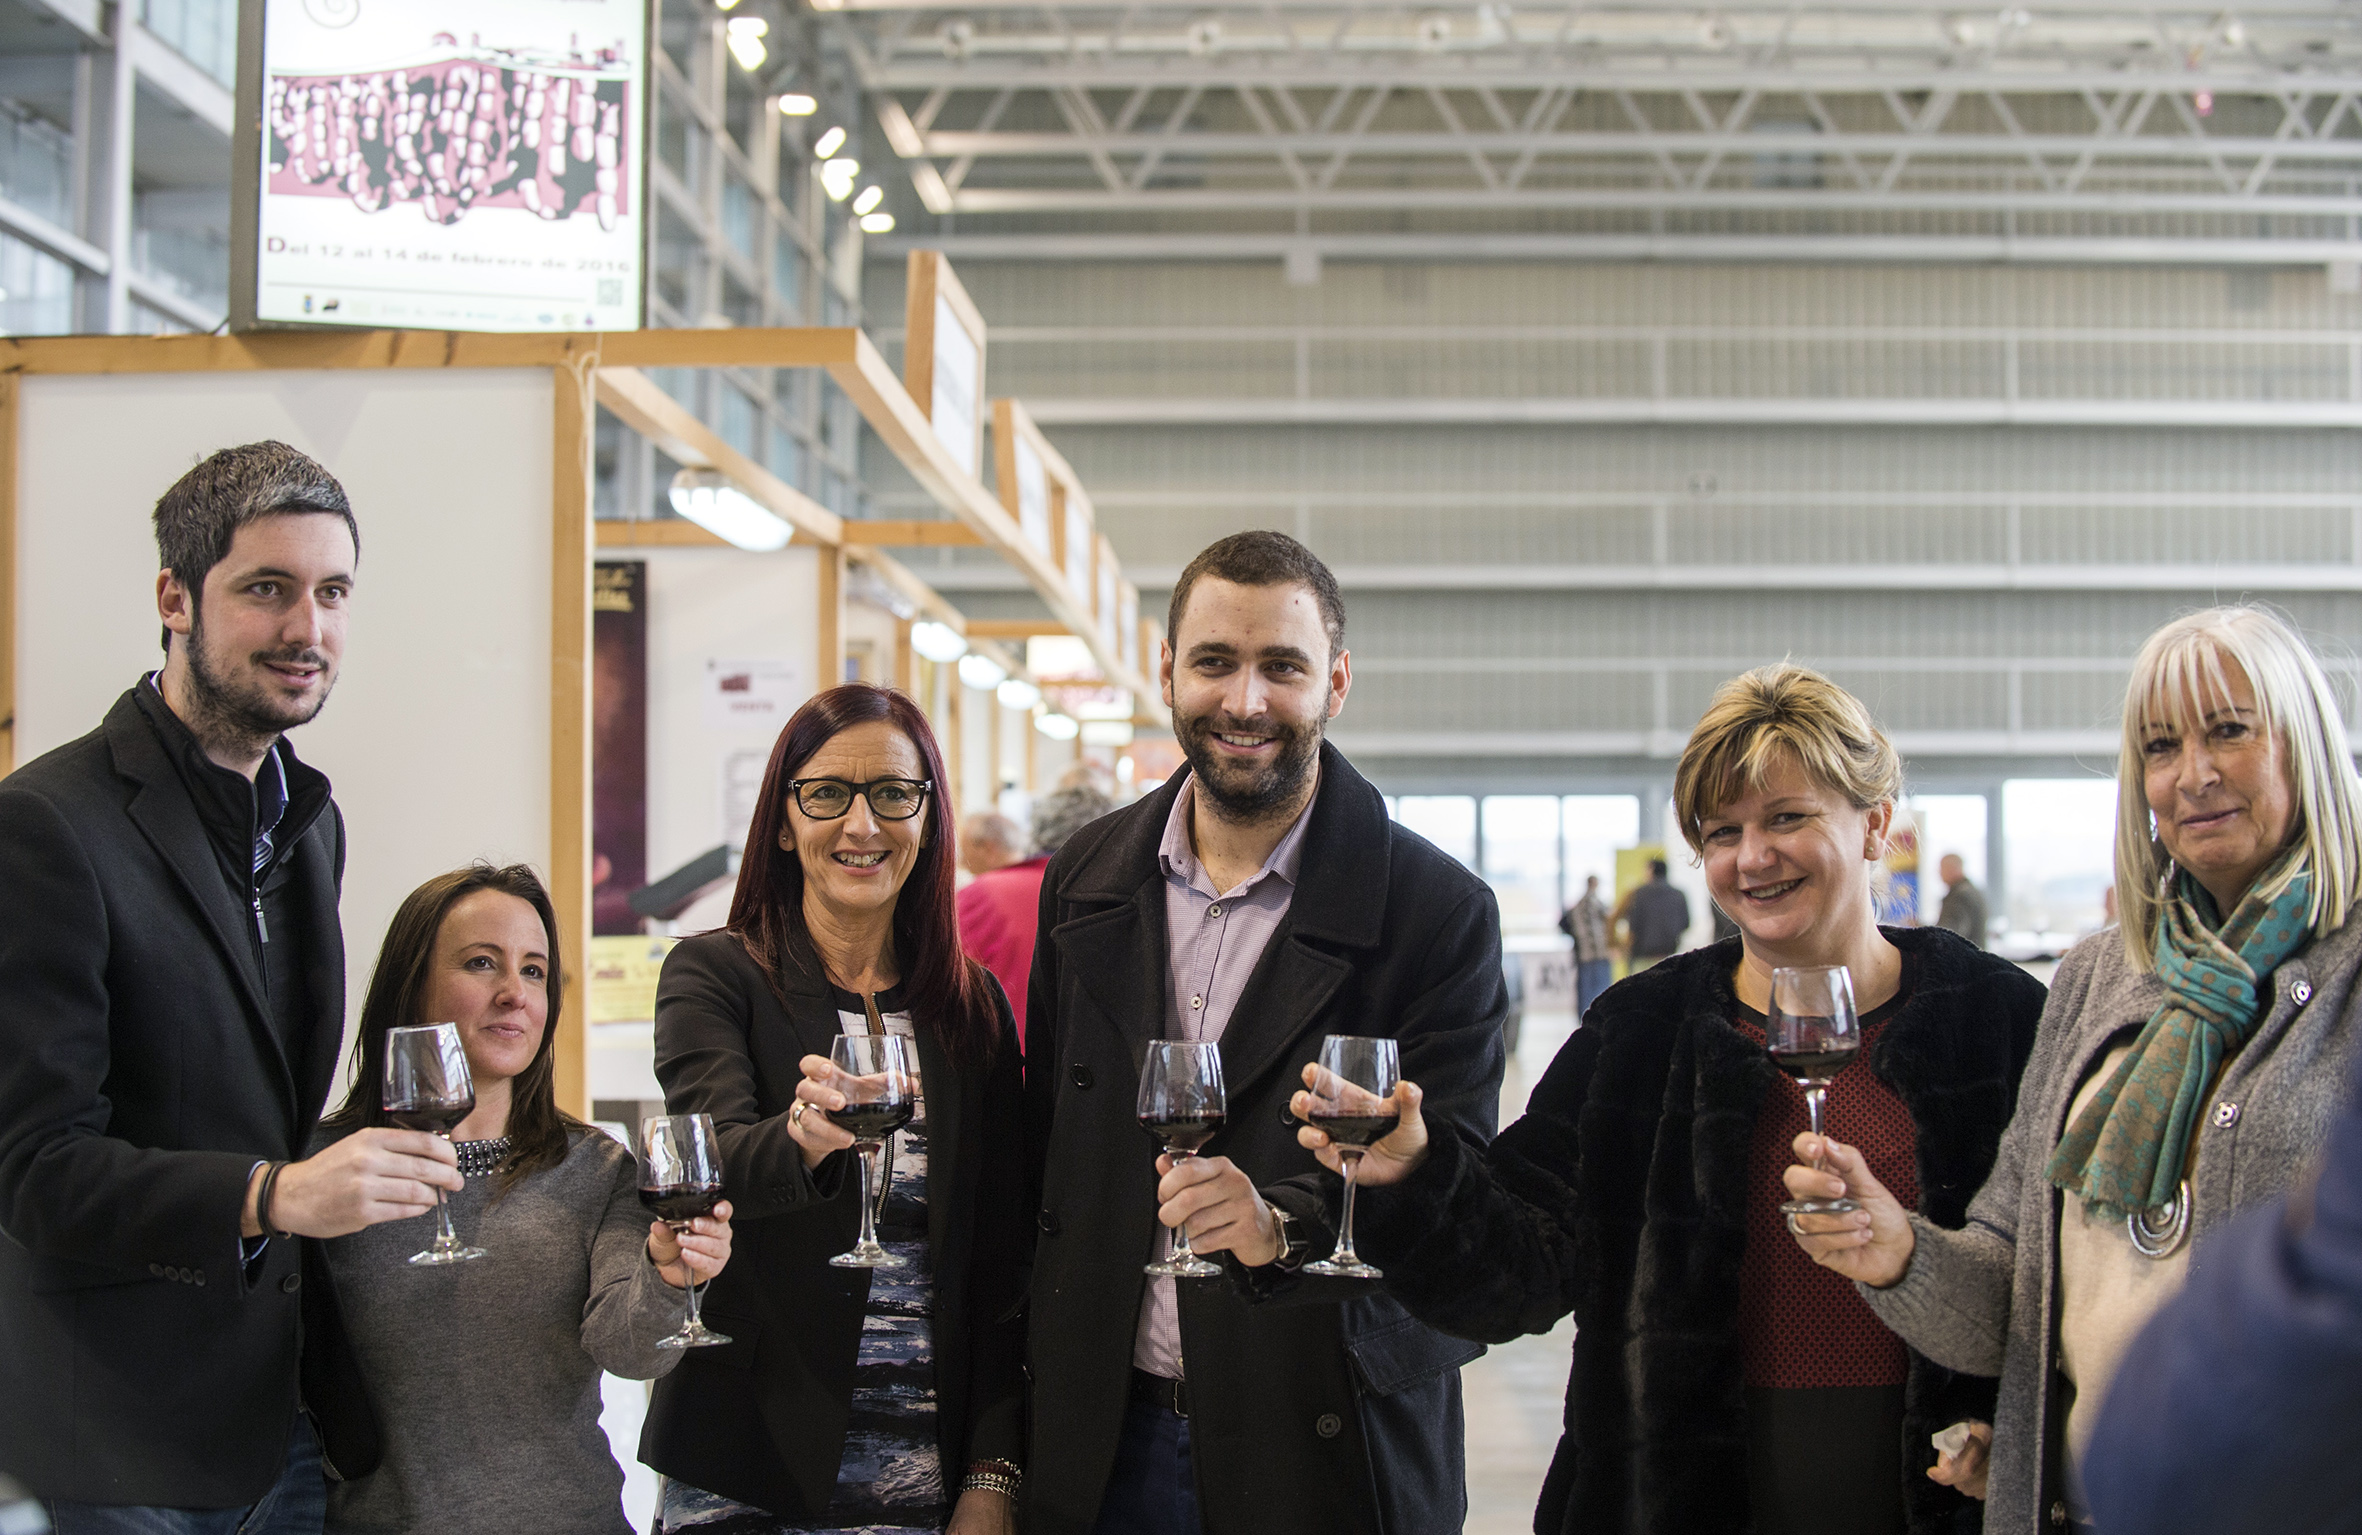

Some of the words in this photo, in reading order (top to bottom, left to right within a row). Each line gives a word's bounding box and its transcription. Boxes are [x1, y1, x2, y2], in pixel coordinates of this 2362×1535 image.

[267, 236, 308, 255] Del
[320, 244, 343, 258] 12
[353, 247, 372, 259] al
[384, 248, 408, 260] 14
[416, 250, 443, 263] de
[452, 252, 532, 268] febrero
[541, 257, 567, 269] de
[576, 259, 630, 273] 2016
